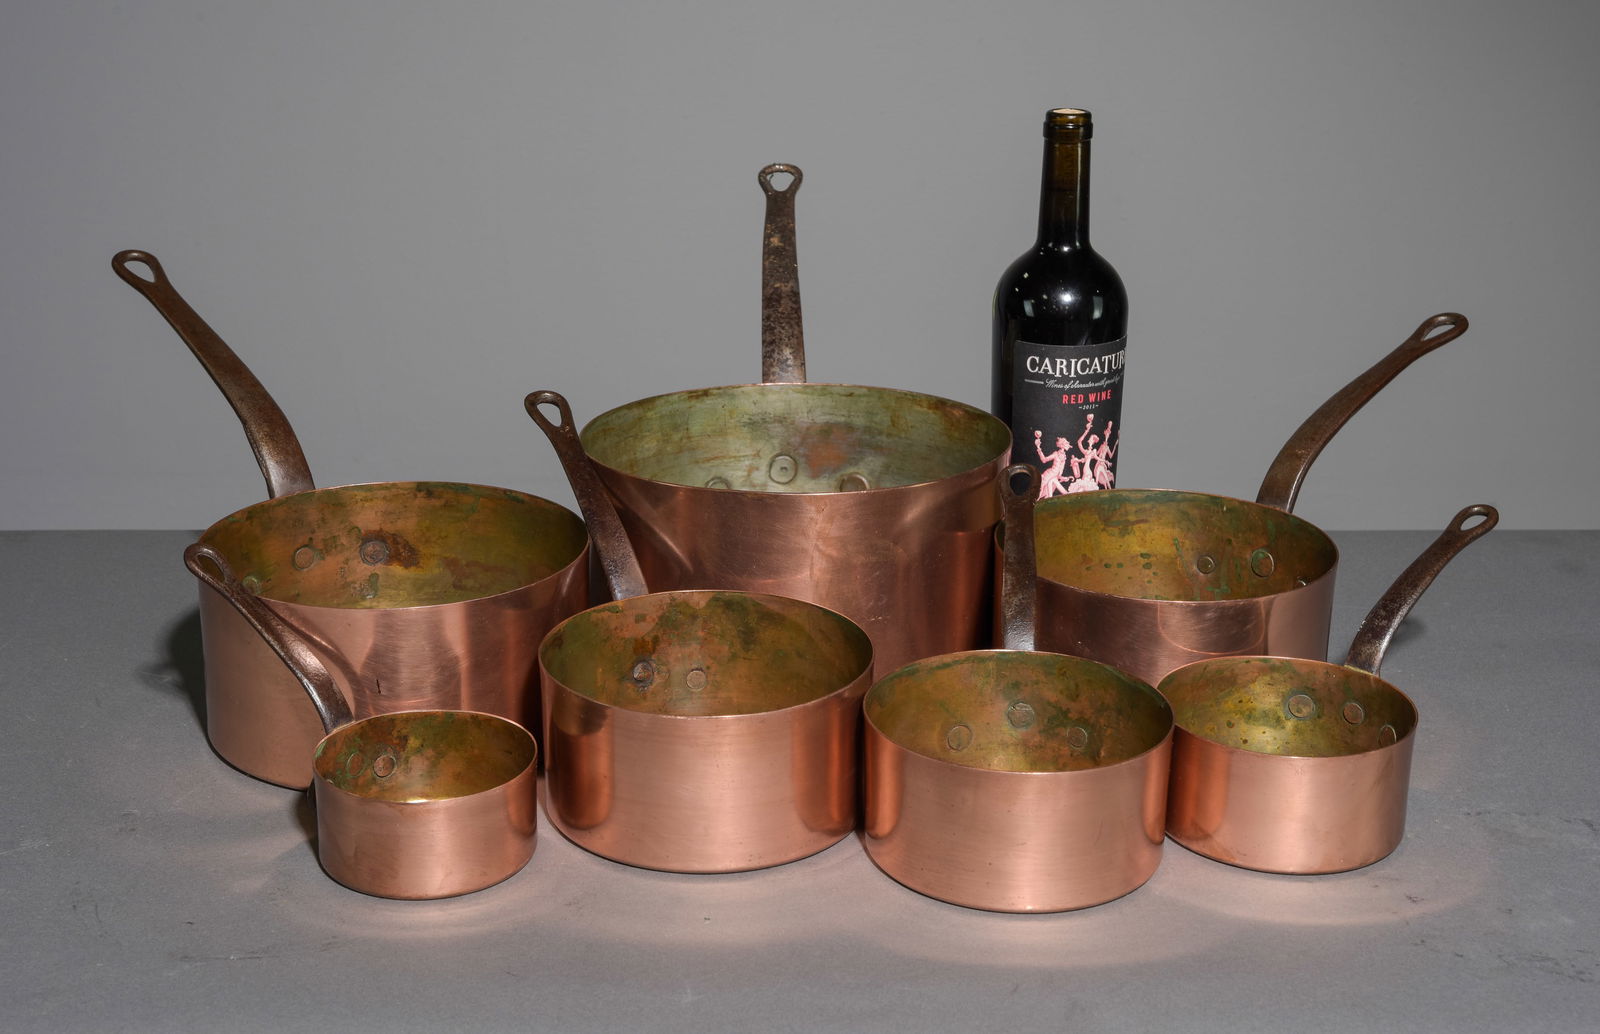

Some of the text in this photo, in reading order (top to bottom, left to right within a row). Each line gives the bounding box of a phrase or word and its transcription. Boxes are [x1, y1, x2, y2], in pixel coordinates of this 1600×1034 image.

[1045, 378, 1064, 389] Wines
[1062, 390, 1112, 405] RED WINE
